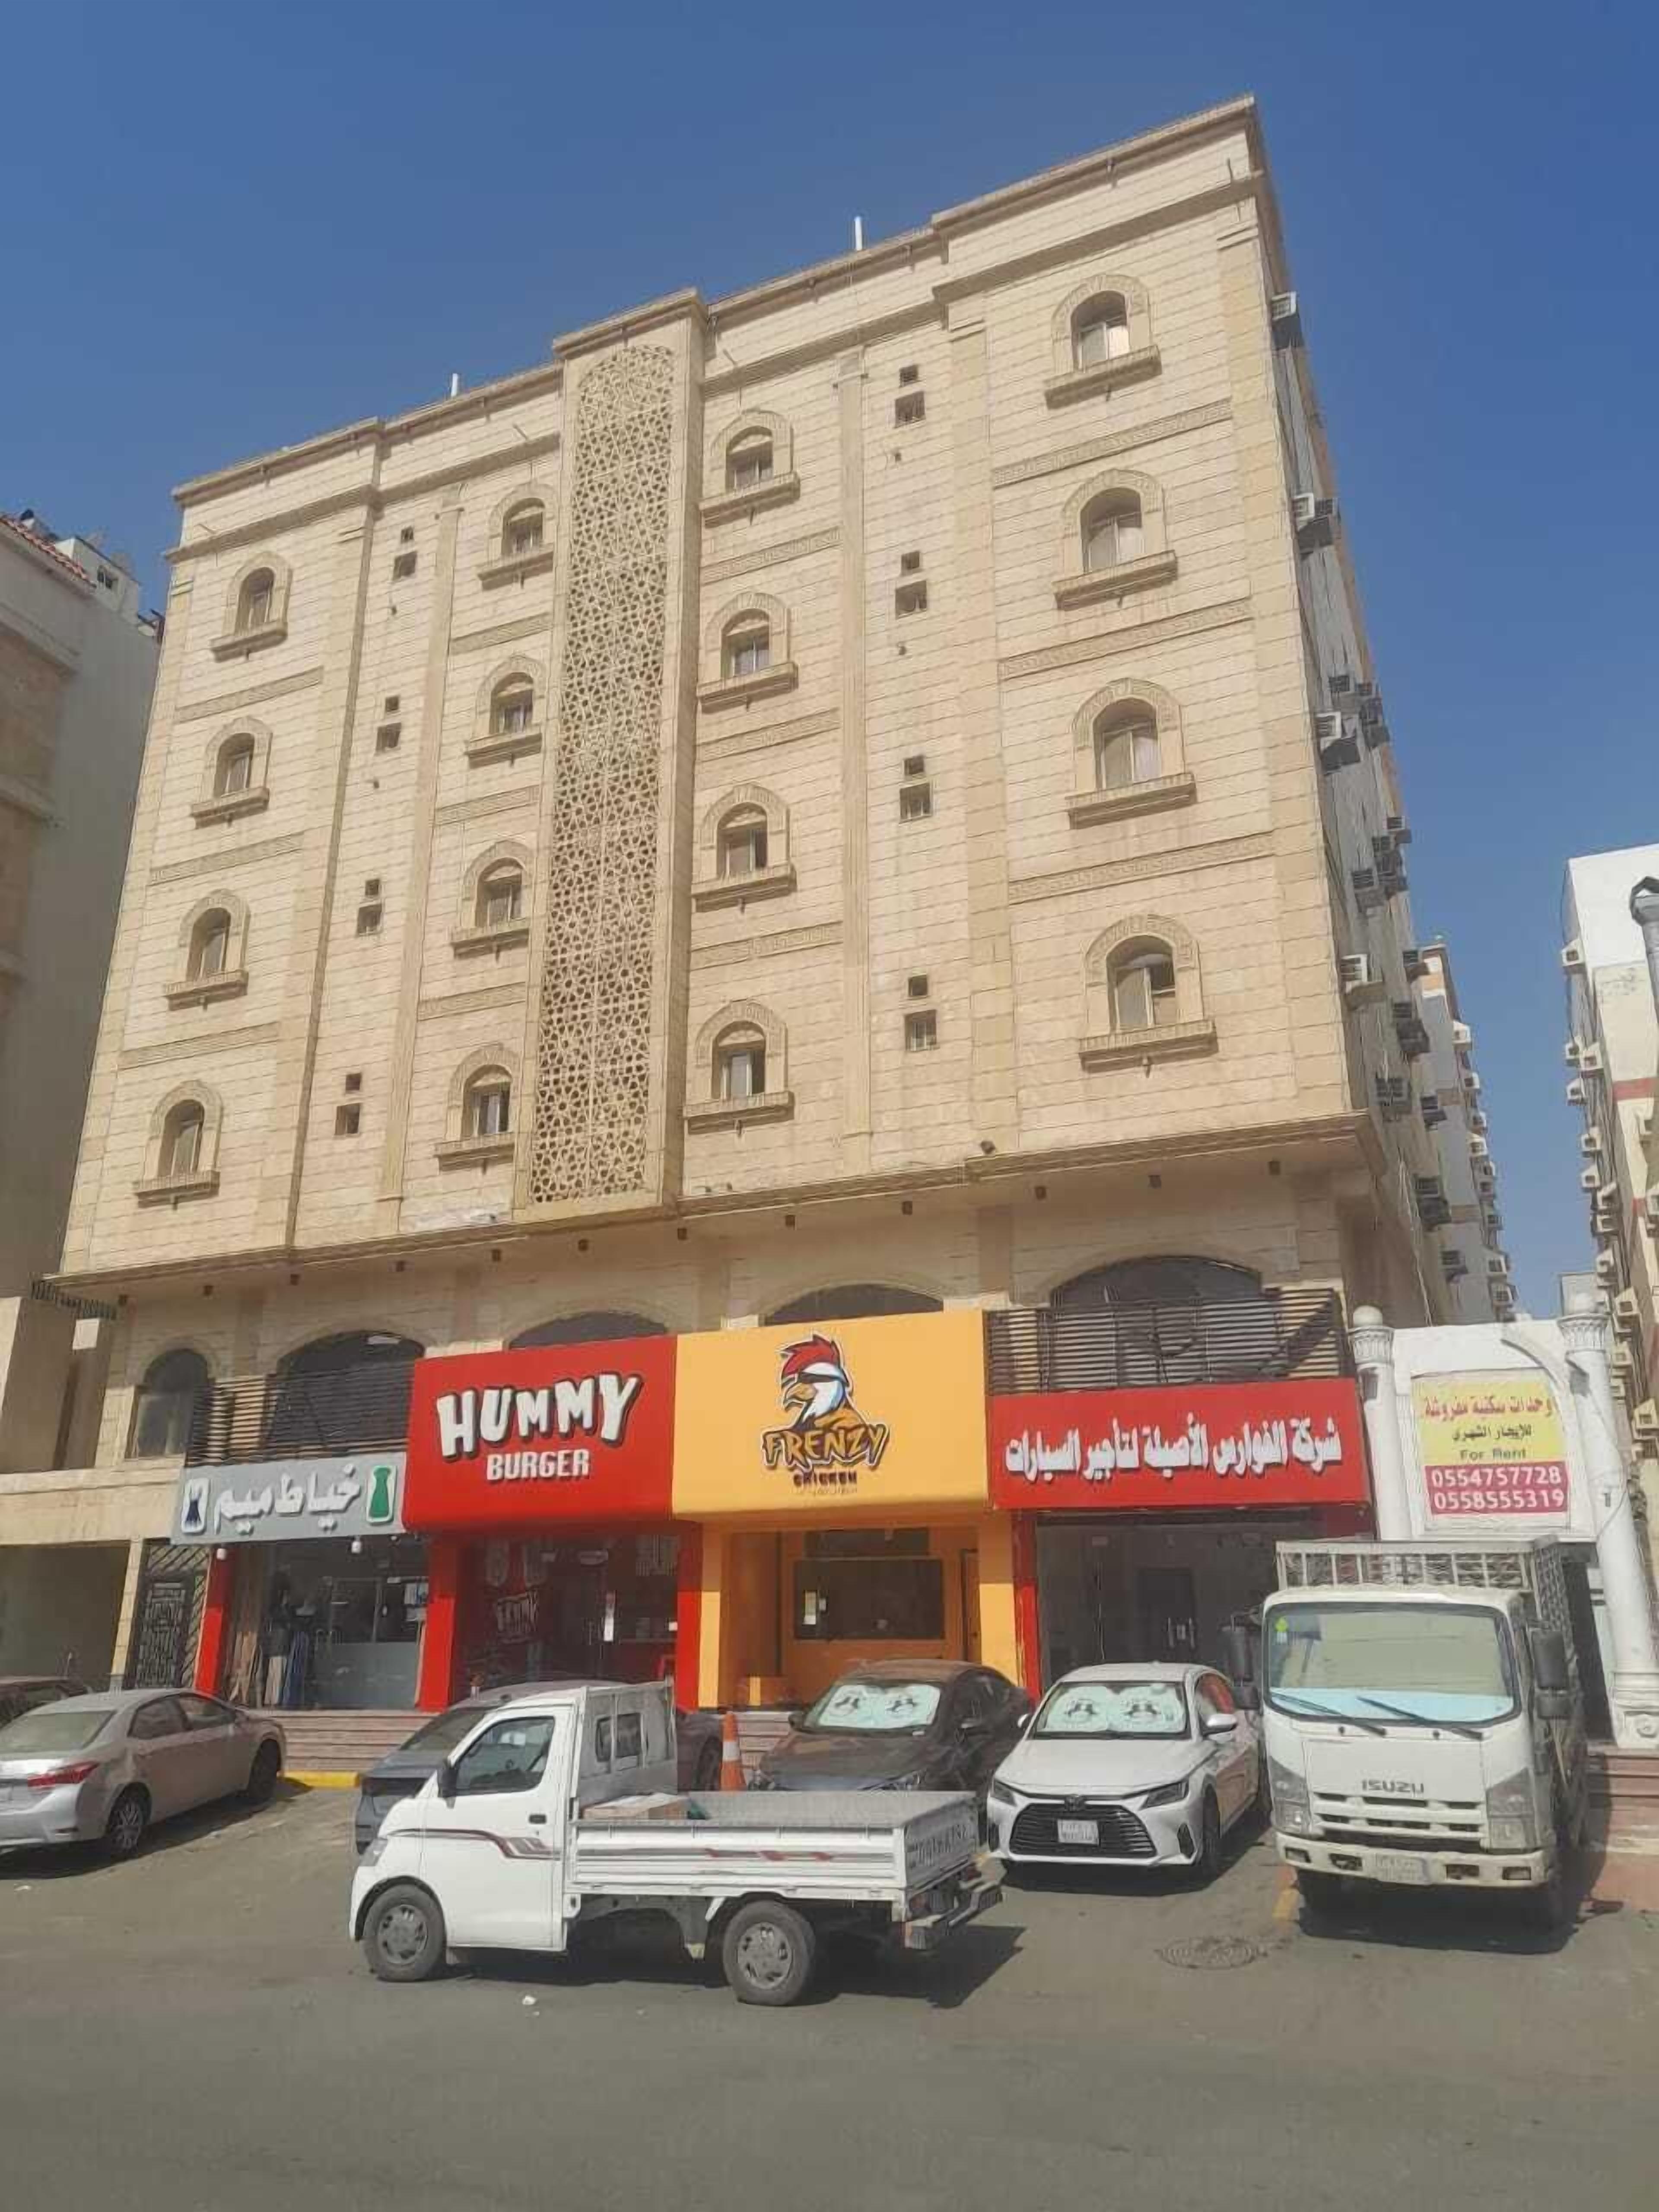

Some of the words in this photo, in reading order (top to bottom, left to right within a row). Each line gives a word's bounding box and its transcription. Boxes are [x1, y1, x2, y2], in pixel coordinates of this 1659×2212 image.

[435, 1372, 641, 1459] HUMMY
[486, 1448, 590, 1481] BURGER
[762, 1424, 889, 1469] FRENZY
[1006, 1428, 1081, 1482] السيارات
[1083, 1417, 1139, 1480] لتأجير
[1142, 1411, 1208, 1478] الأصيلة
[1212, 1420, 1288, 1475] الفوارس
[1290, 1417, 1342, 1472] شركة
[1460, 1449, 1484, 1460] For
[1493, 1448, 1526, 1459] Rent
[274, 1463, 361, 1532] خياط
[1431, 1465, 1561, 1487] 0554757728
[1433, 1488, 1564, 1510] 0558555319
[1361, 1778, 1425, 1795] ISUZU
